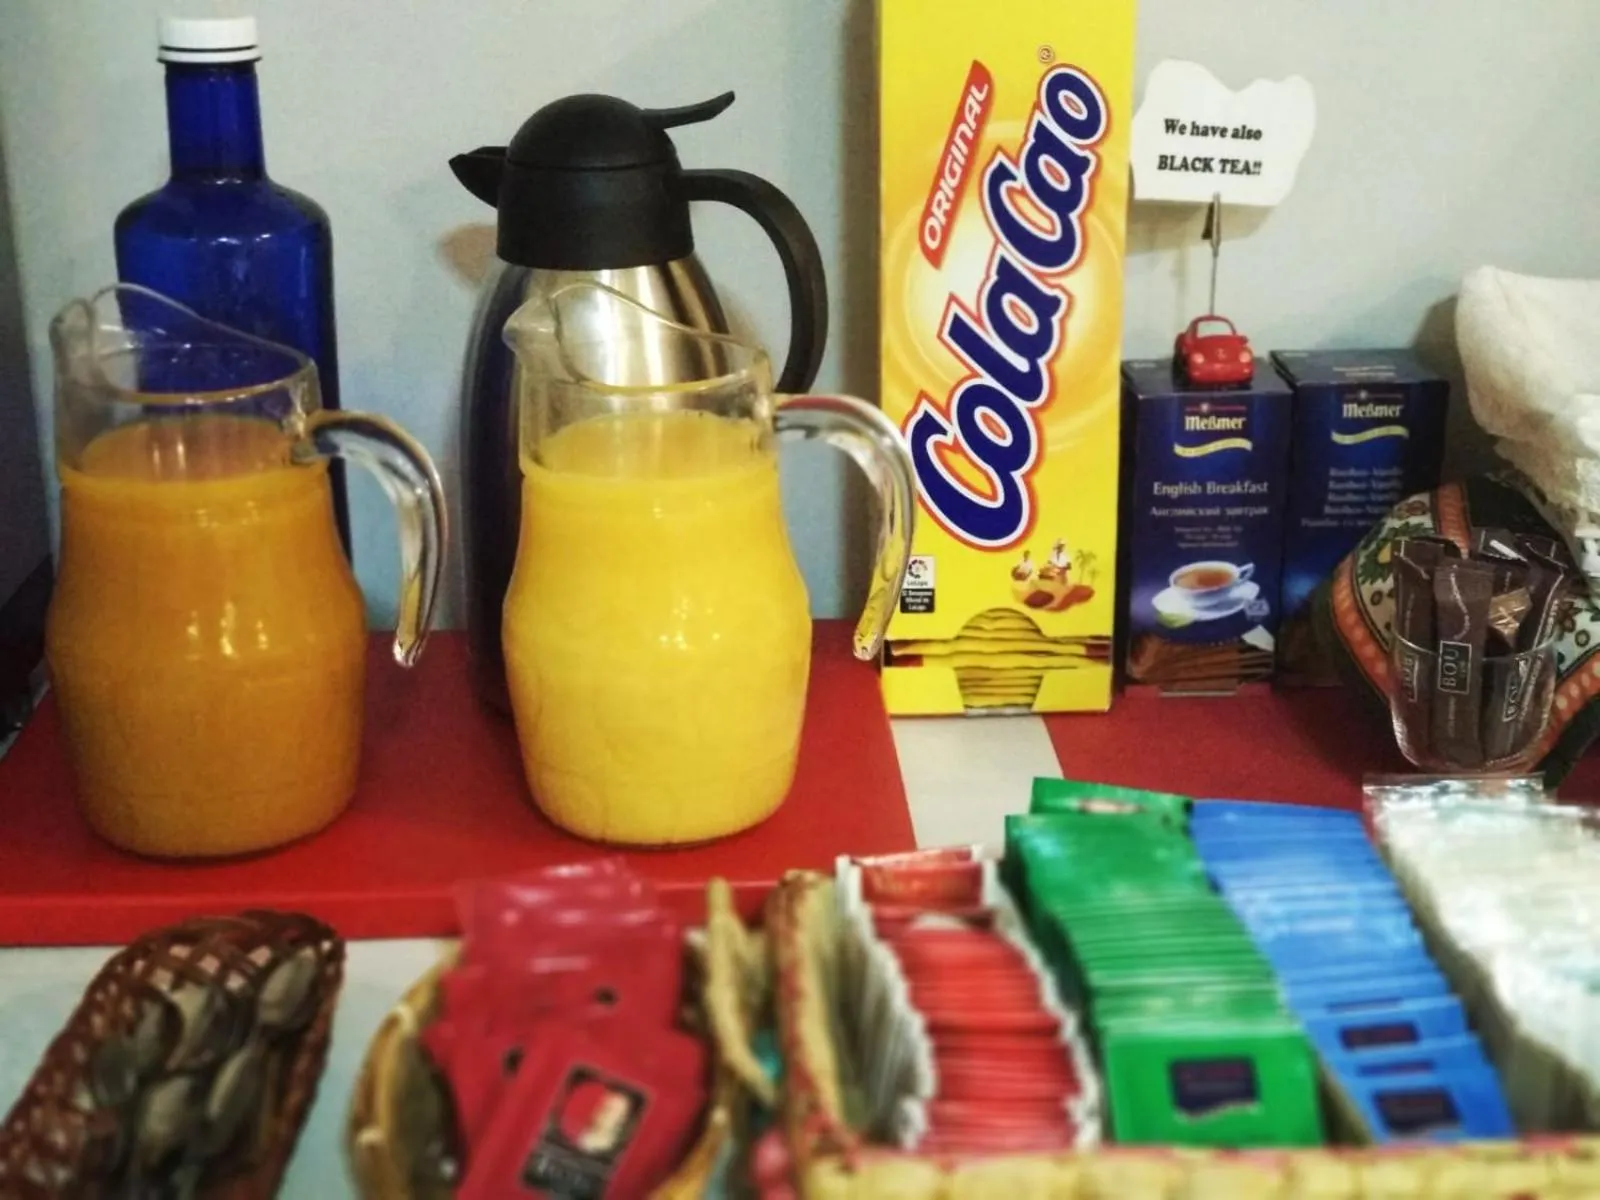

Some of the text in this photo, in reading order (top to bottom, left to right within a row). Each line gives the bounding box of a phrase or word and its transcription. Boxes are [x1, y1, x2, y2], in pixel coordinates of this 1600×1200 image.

[1164, 118, 1262, 140] We have also
[924, 83, 989, 249] ORIGINAL
[1158, 155, 1262, 175] BLACK TEA!!
[1343, 403, 1404, 418] Meßmer
[1185, 415, 1246, 430] Meßmer
[1153, 480, 1269, 499] English Breakfast
